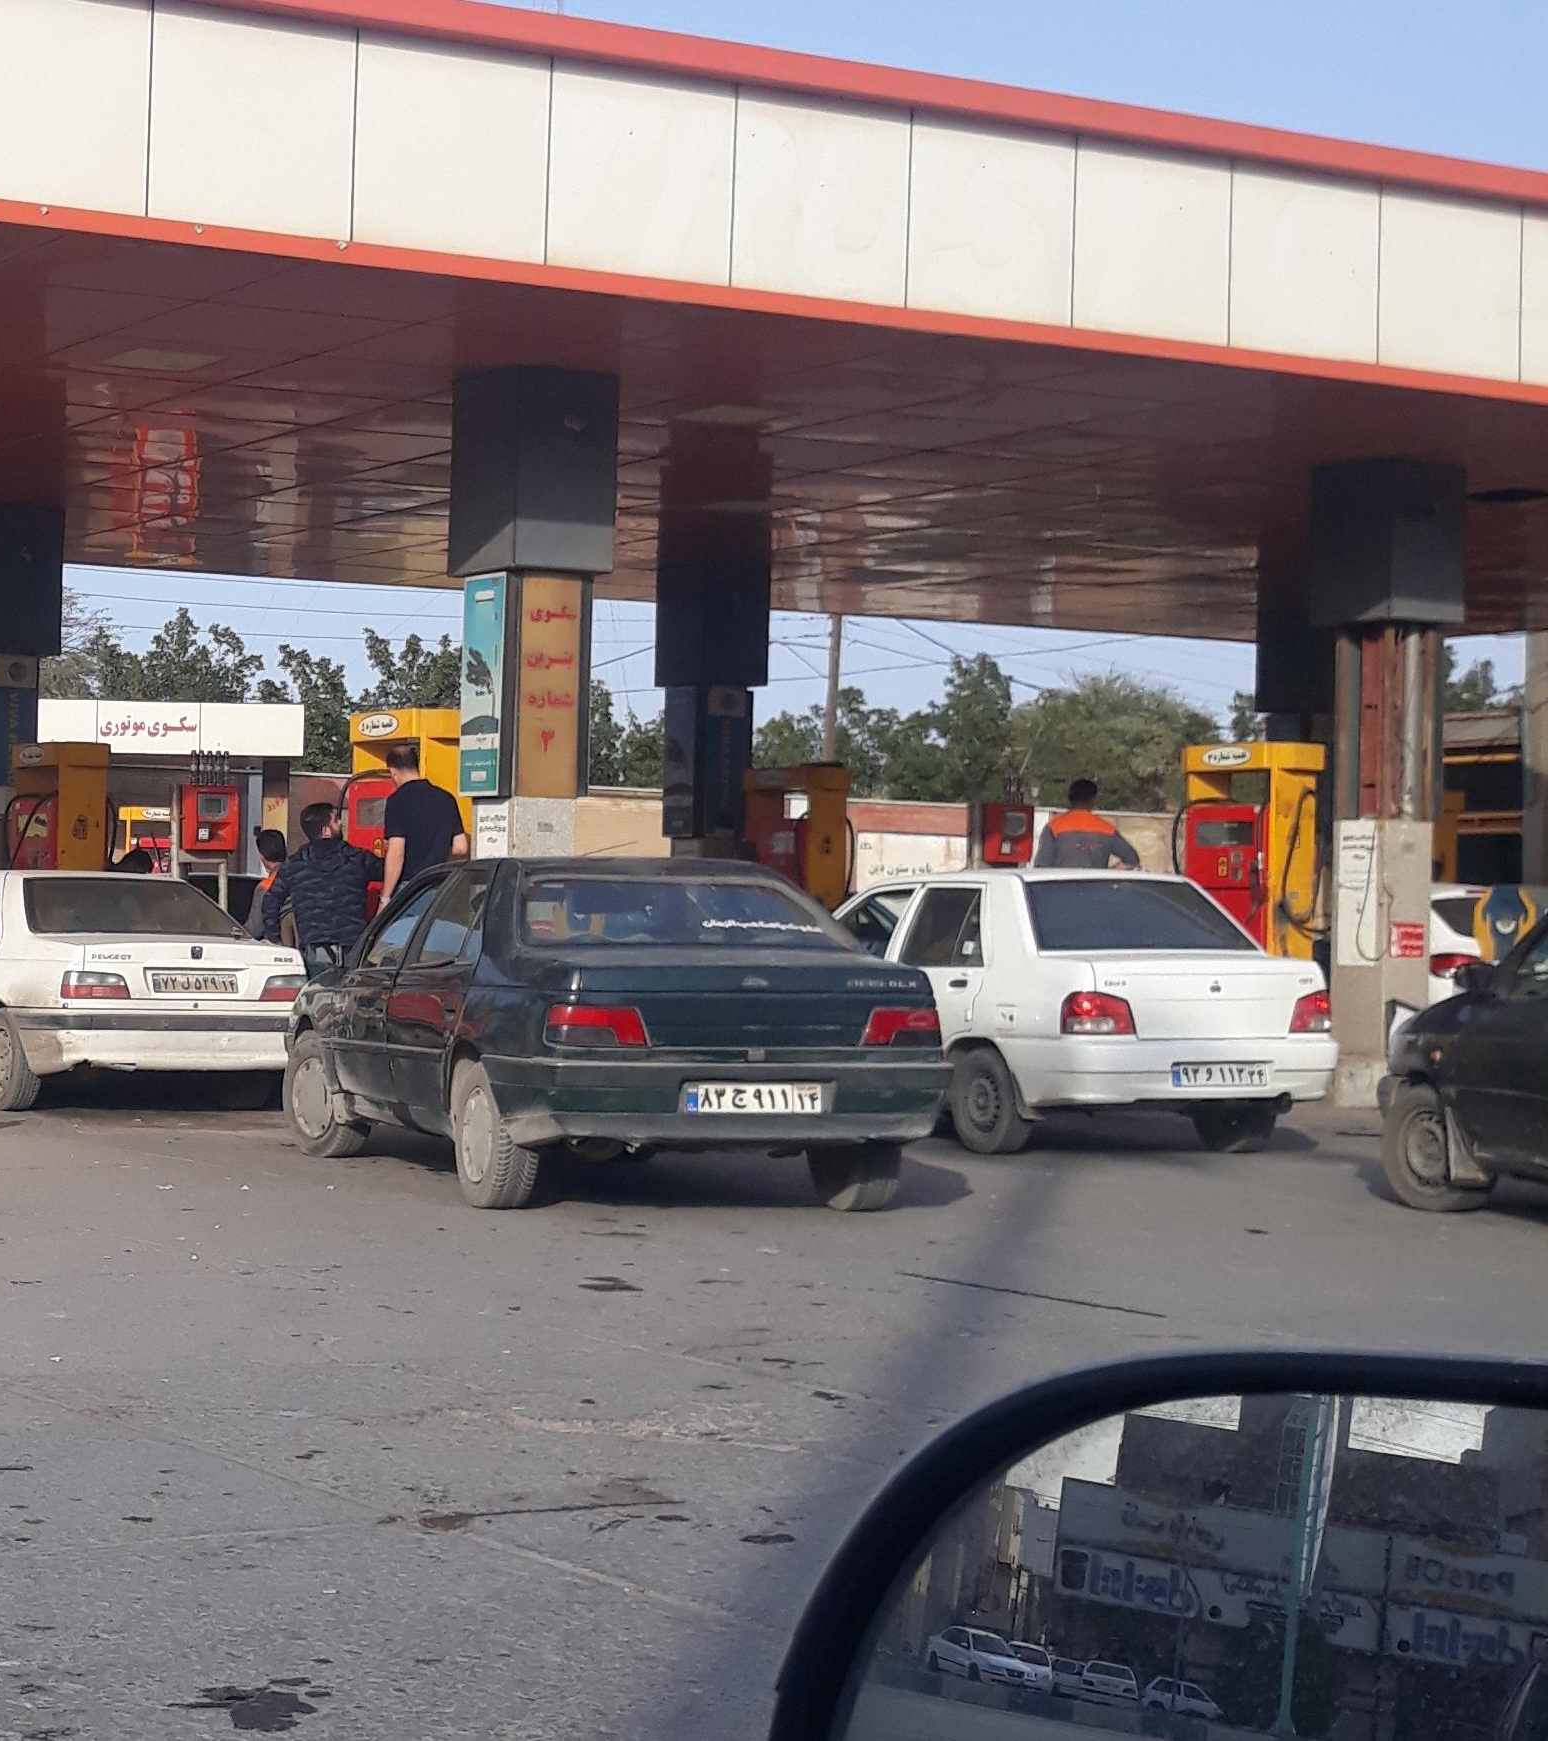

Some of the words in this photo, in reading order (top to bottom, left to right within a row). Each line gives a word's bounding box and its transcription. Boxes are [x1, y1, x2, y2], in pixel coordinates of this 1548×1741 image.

[528, 688, 574, 708] شماره
[100, 715, 146, 737] موتوری
[148, 716, 197, 737] سکوی
[92, 953, 132, 961] PEUGEOT
[753, 1088, 789, 1110] ۹۱۱
